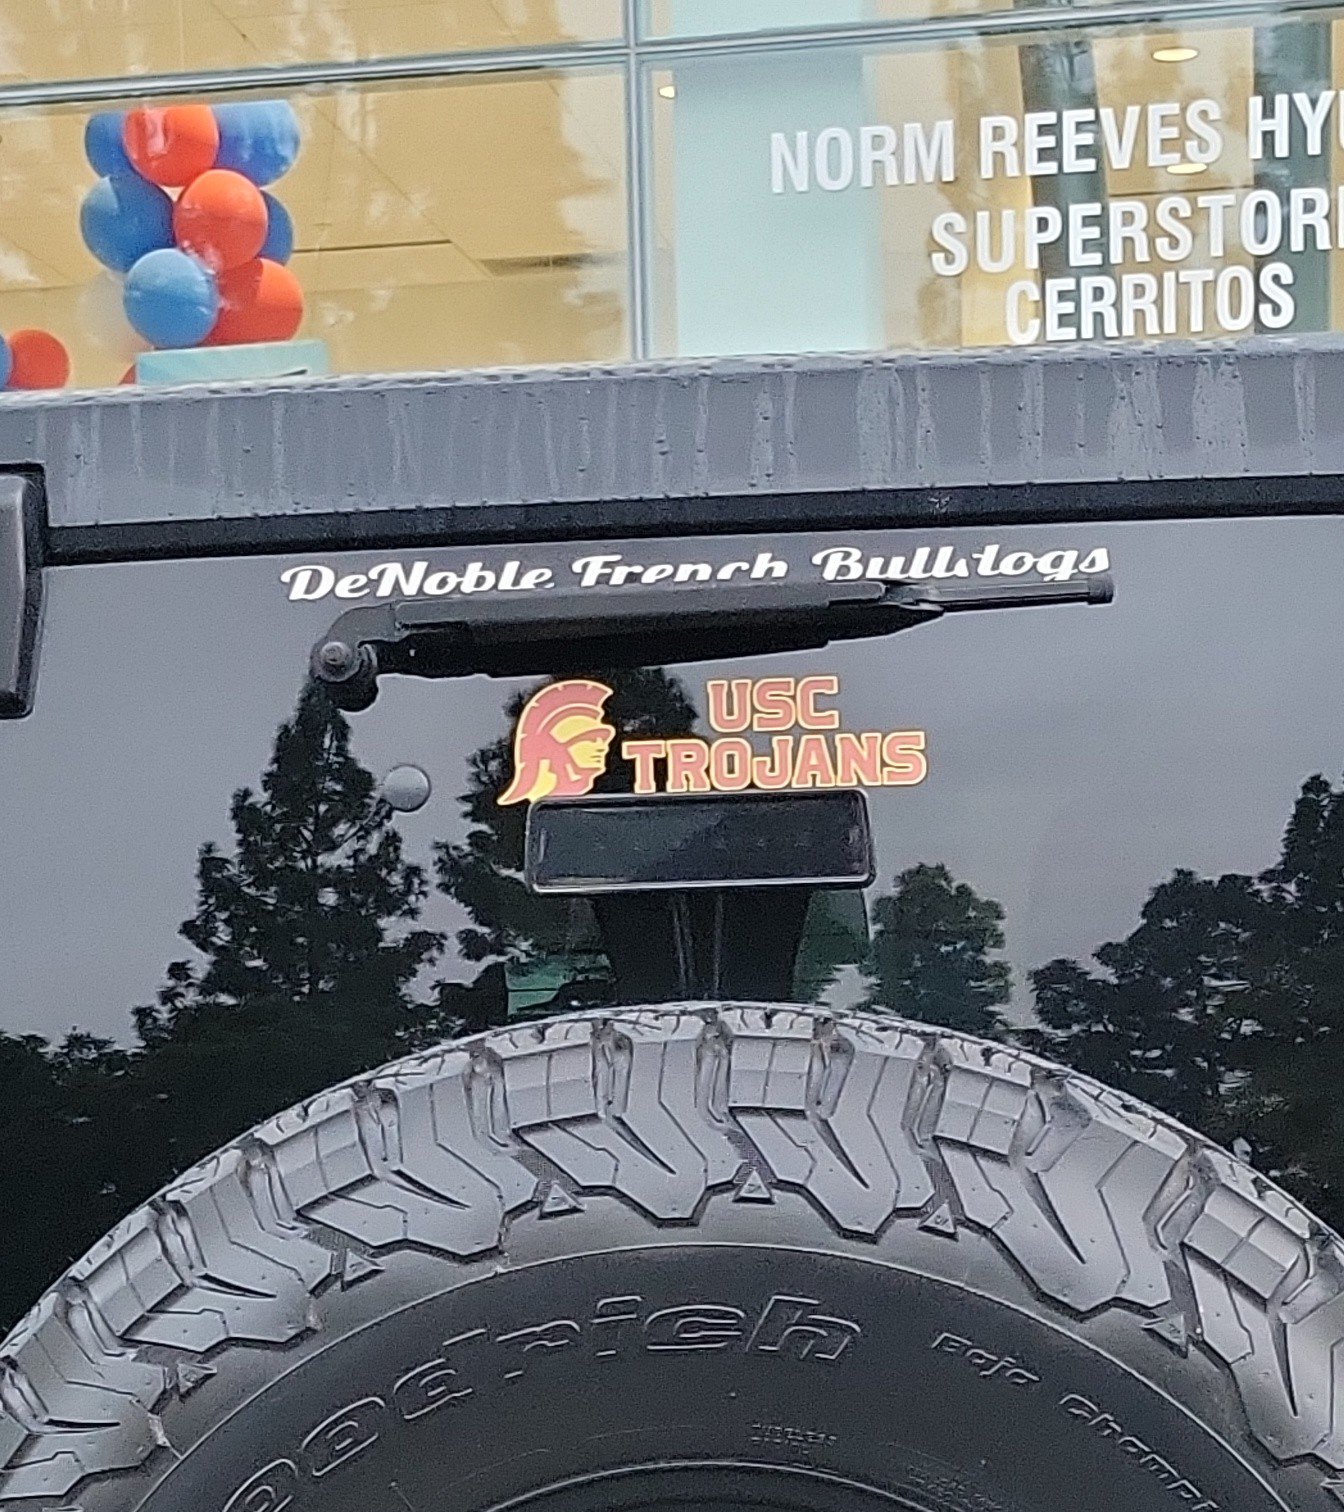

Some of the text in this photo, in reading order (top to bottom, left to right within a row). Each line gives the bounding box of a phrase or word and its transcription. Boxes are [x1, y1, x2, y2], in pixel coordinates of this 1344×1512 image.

[769, 121, 955, 193] NORM
[979, 99, 1223, 180] REEVES
[1005, 263, 1297, 345] CERRITOS
[280, 559, 556, 601] DeNoble
[571, 552, 789, 589] French
[706, 676, 840, 733] USC
[620, 730, 928, 796] TROJANS
